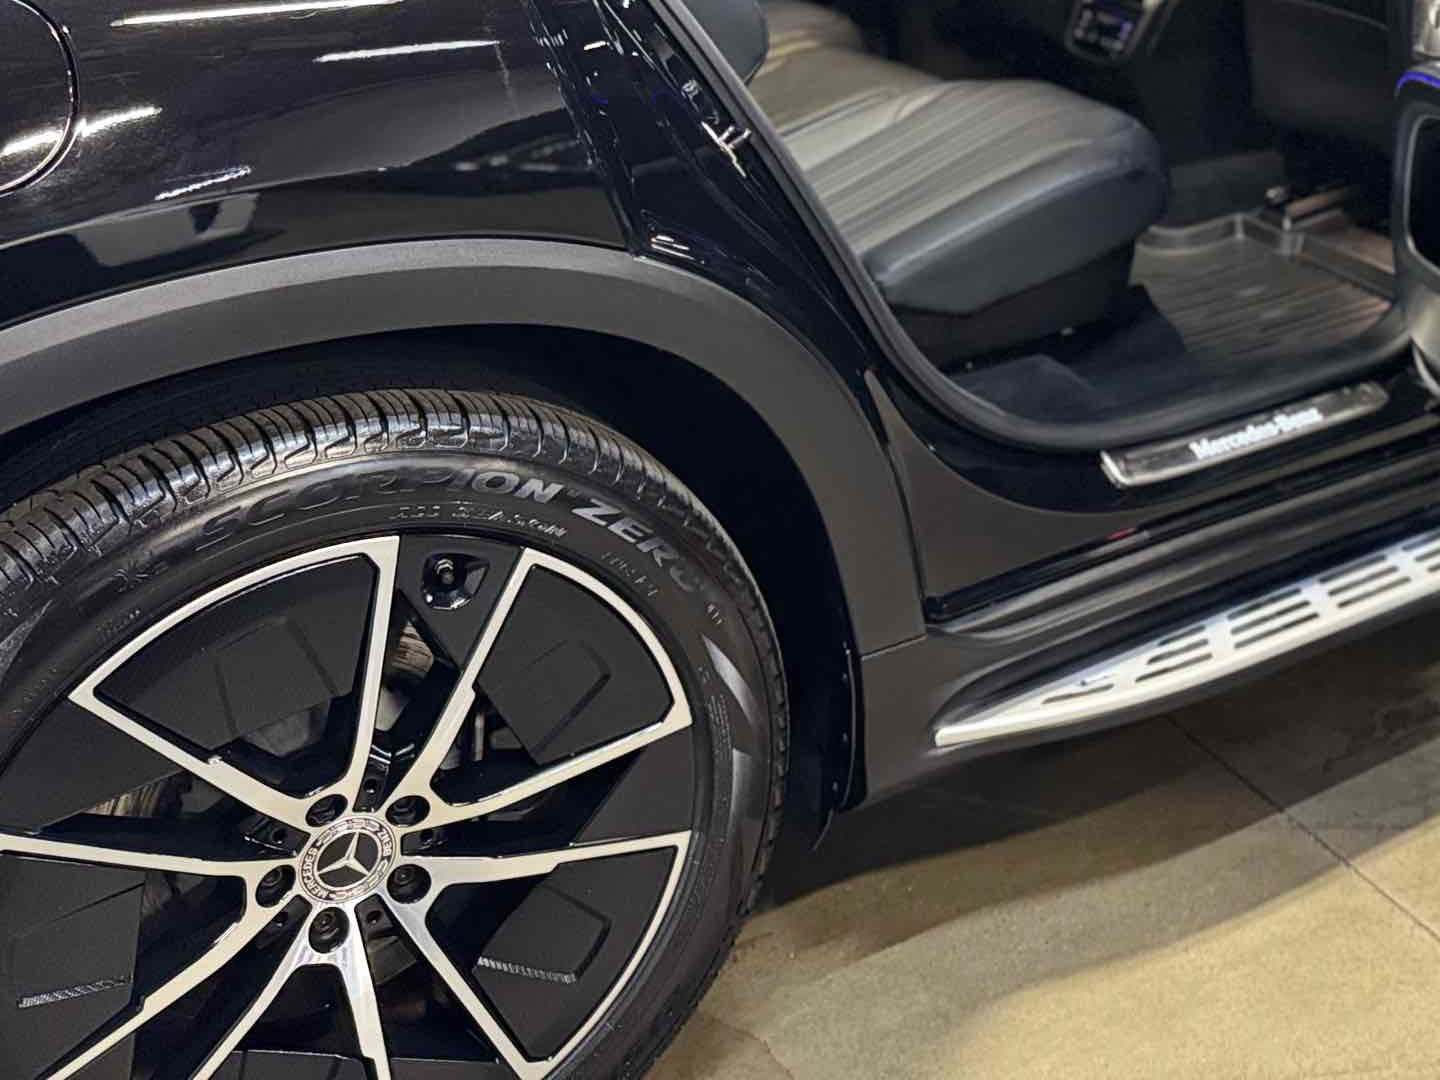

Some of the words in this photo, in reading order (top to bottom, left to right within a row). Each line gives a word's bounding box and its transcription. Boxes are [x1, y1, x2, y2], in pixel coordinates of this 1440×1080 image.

[195, 468, 564, 551] SCORPION
[571, 498, 703, 593] ZERO
[303, 846, 329, 899] MERCEDES
